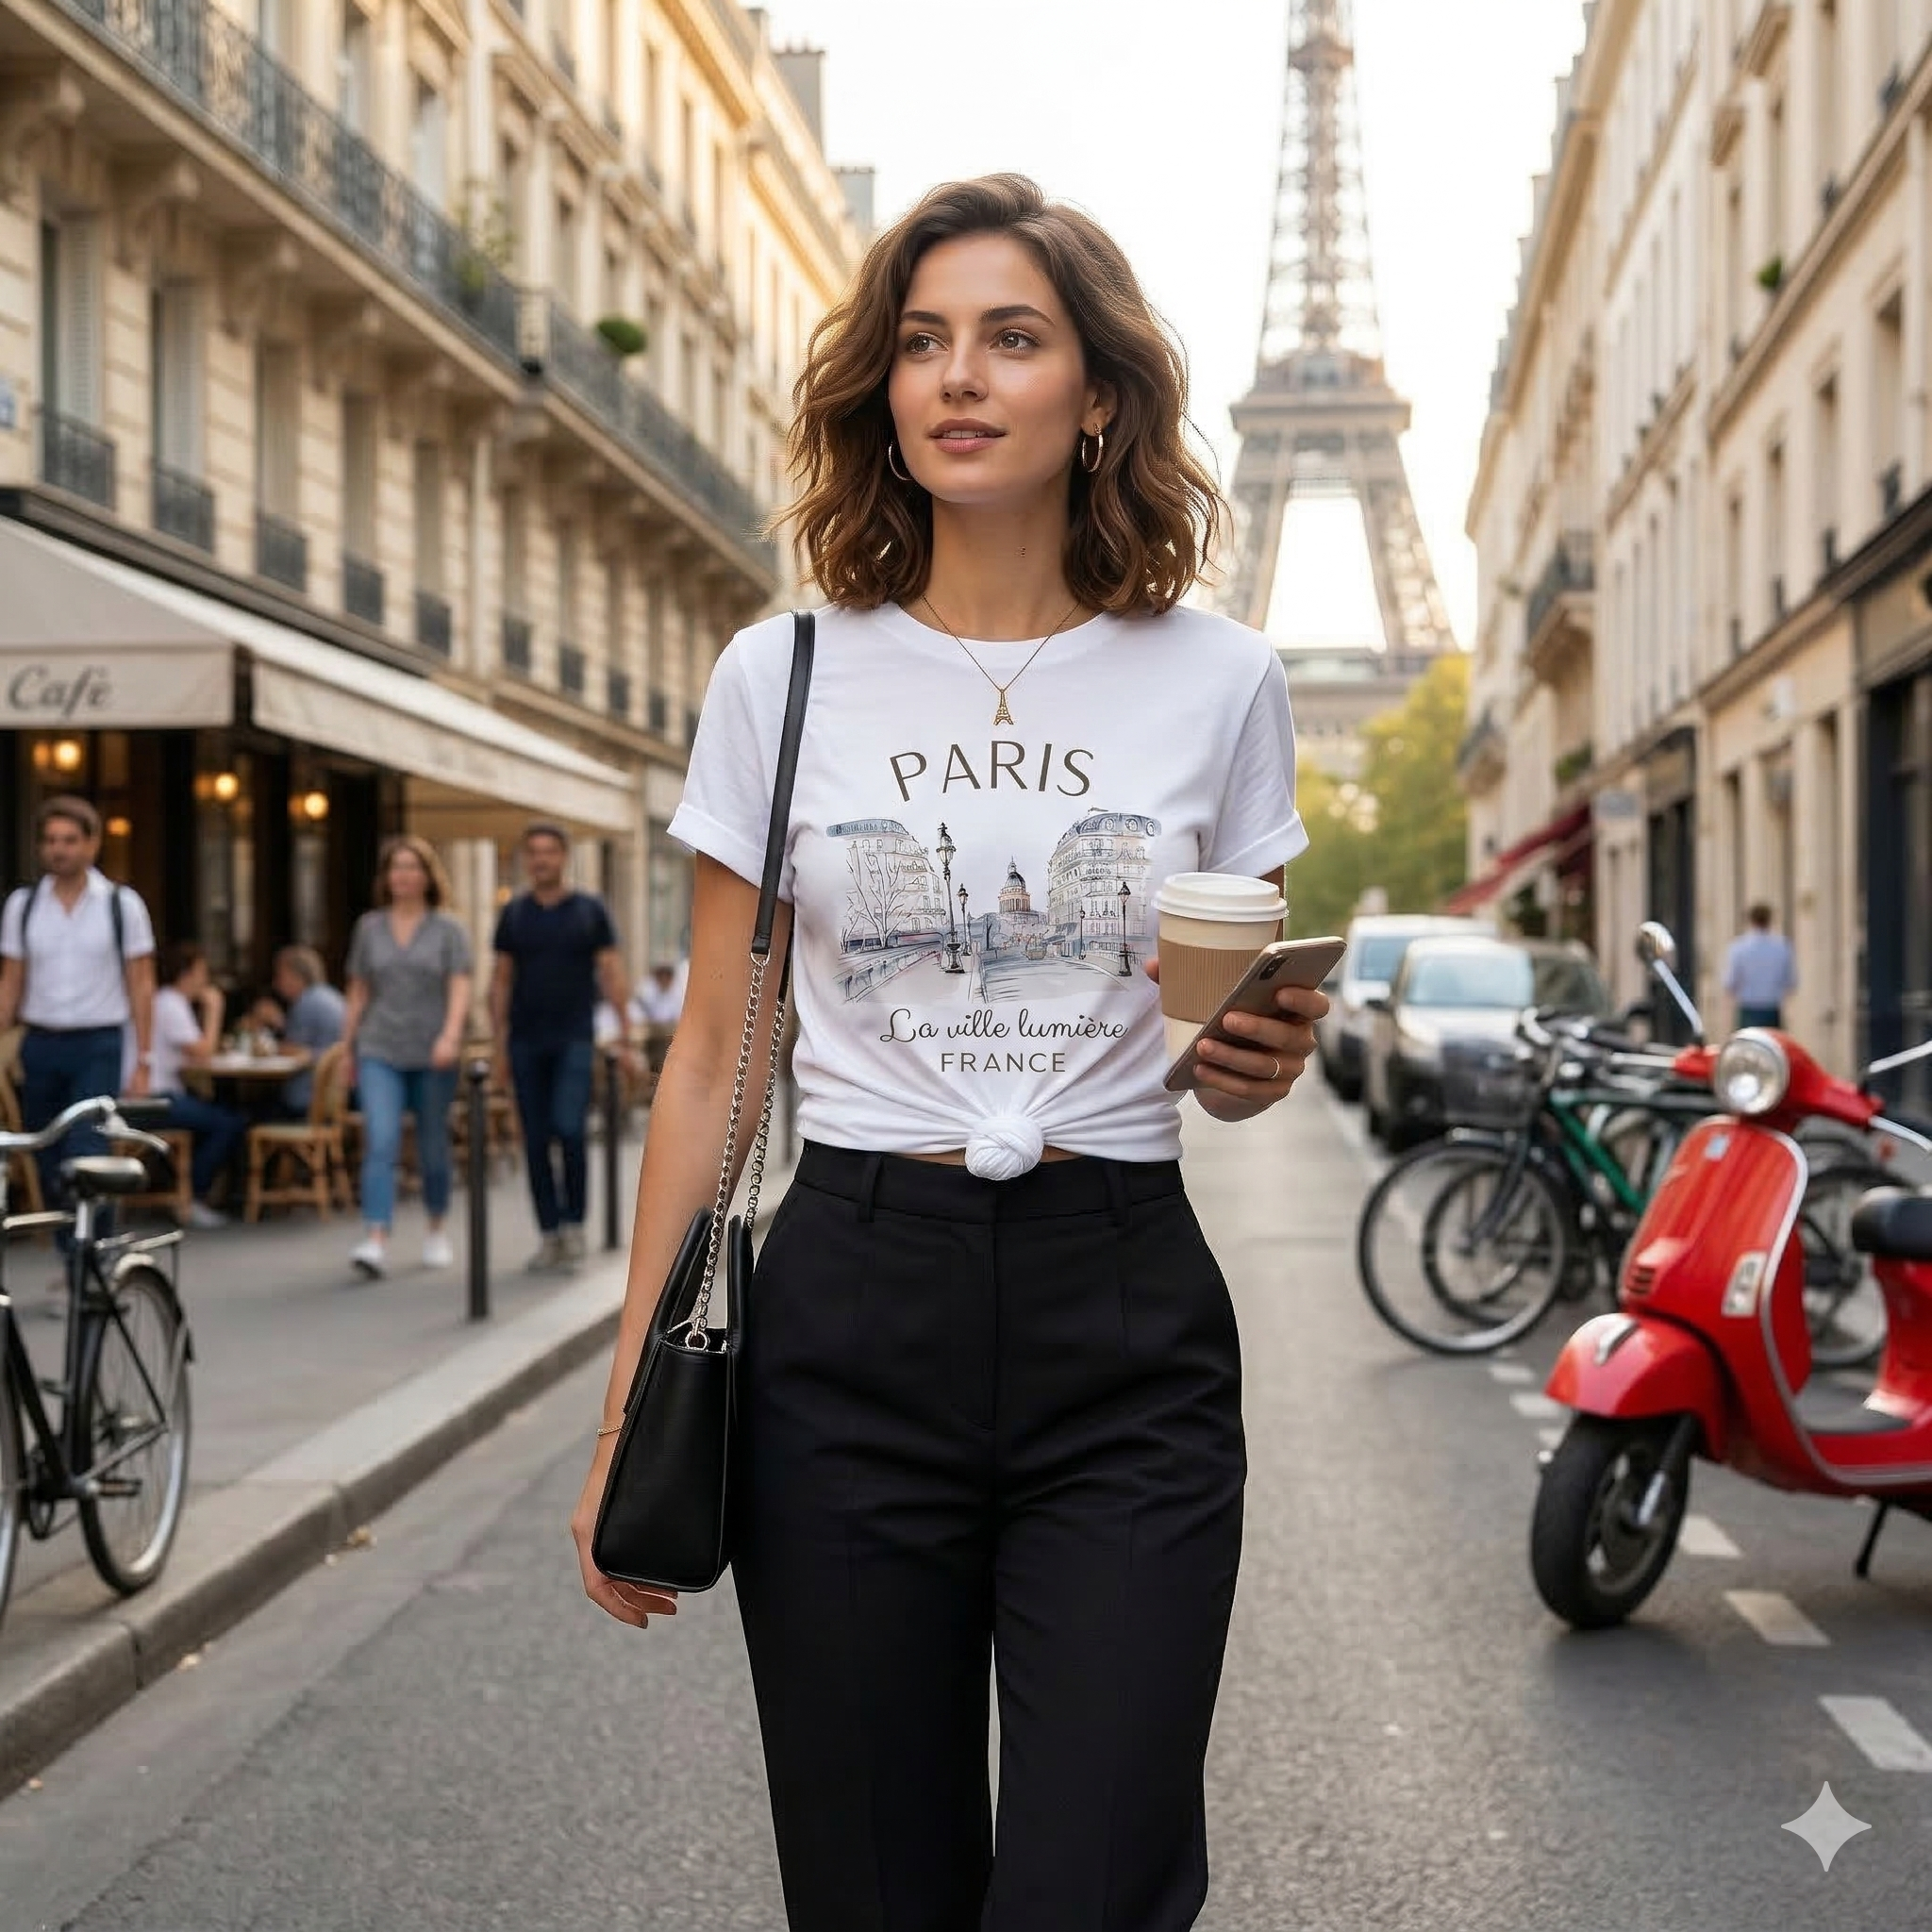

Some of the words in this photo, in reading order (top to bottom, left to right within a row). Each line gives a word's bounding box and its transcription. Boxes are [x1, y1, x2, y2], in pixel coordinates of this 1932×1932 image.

[890, 741, 1094, 802] PARIS
[879, 1008, 939, 1042] La
[947, 1009, 1010, 1039] ville
[1019, 1008, 1128, 1039] lumière
[941, 1052, 1066, 1073] FRANCE
